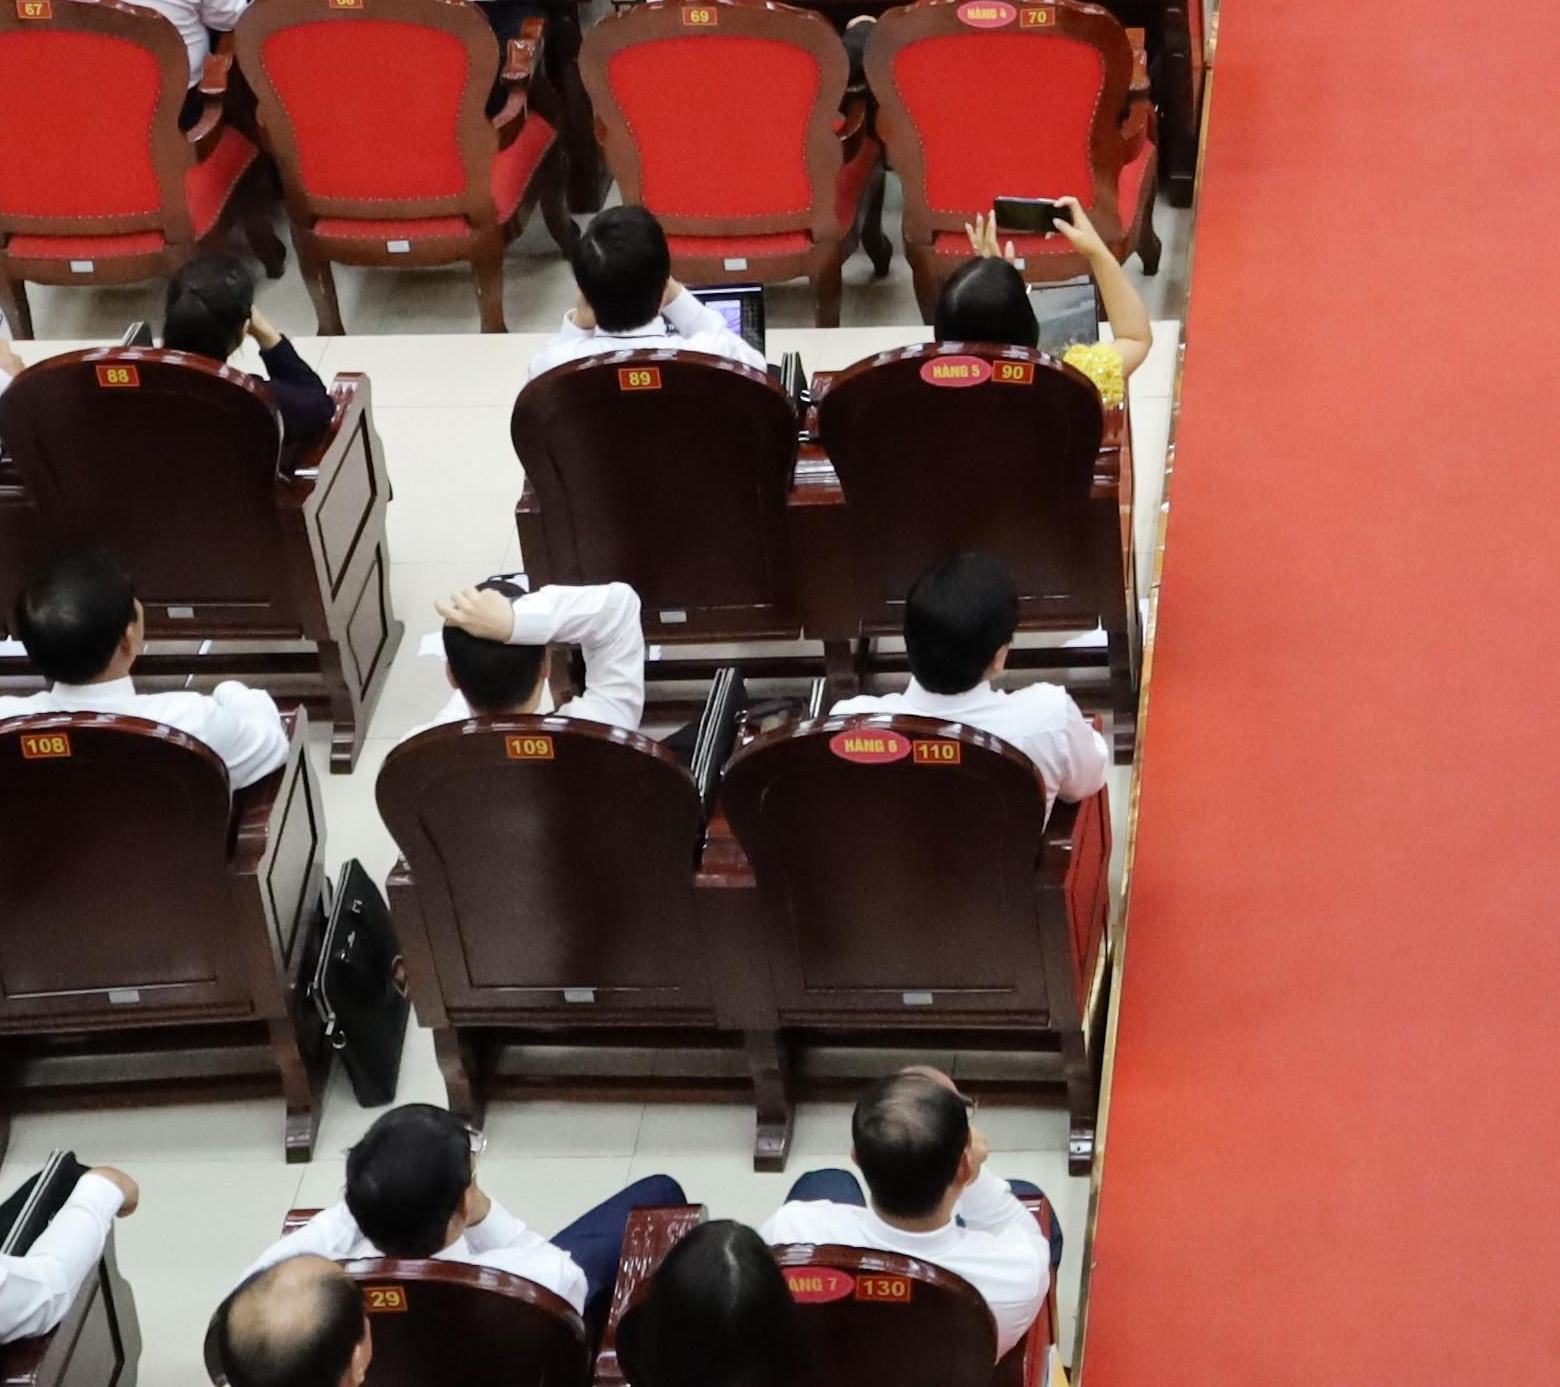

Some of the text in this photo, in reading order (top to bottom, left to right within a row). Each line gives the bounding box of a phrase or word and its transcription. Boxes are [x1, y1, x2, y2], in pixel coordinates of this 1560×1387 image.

[1028, 10, 1047, 24] 70
[932, 363, 980, 379] HÀNG 5
[627, 371, 652, 388] 89
[511, 739, 549, 755] 109
[863, 1280, 905, 1297] 130
